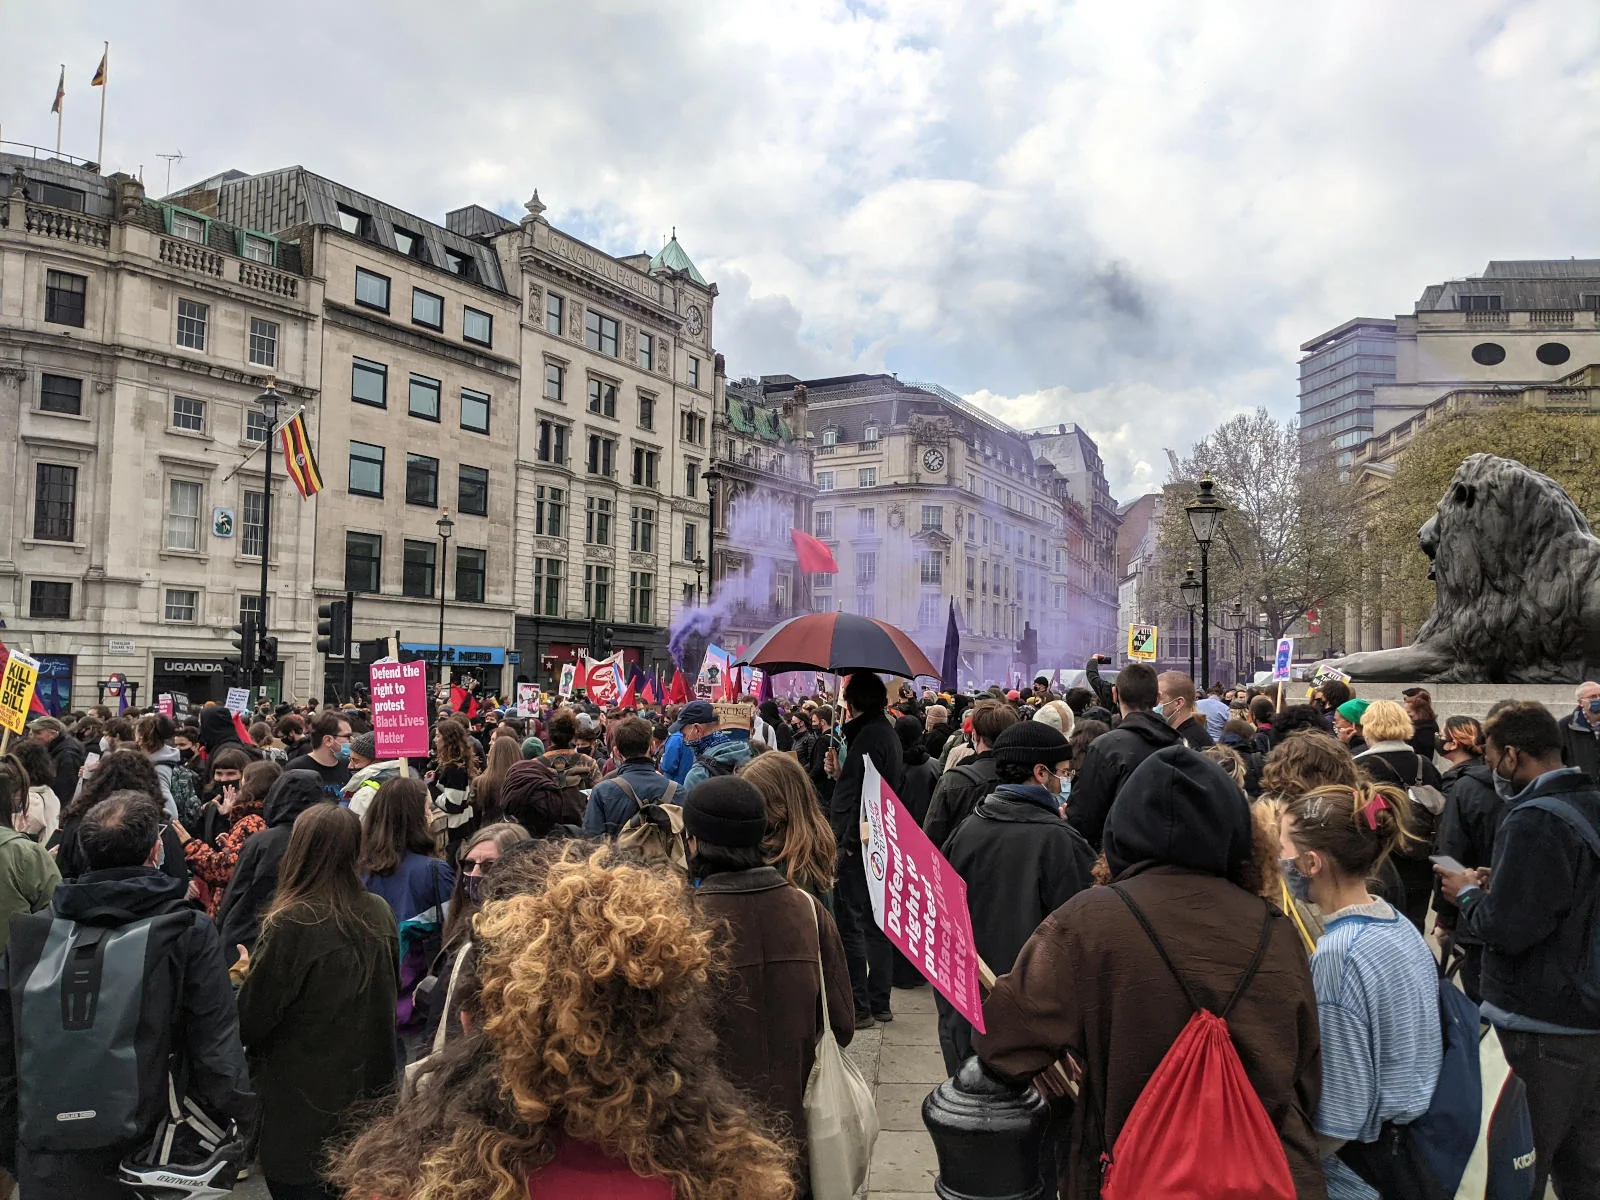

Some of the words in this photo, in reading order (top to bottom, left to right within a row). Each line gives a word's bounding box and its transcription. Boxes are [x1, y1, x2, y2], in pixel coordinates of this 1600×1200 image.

[550, 236, 613, 279] CANADIAN
[616, 266, 658, 298] PACIFIC
[164, 661, 223, 672] UGANDA
[458, 651, 492, 662] NERO
[8, 662, 31, 686] KILL
[372, 665, 401, 680] Defend
[402, 665, 420, 678] the
[5, 676, 27, 698] THE
[374, 683, 393, 698] right
[395, 683, 405, 694] to
[1, 690, 24, 714] BILL
[375, 698, 405, 714] protest
[376, 715, 398, 728] Black
[399, 714, 425, 727] Lives
[377, 731, 404, 744] Matter
[884, 798, 899, 841] the
[906, 853, 919, 882] to
[887, 836, 904, 939] Defend
[931, 851, 949, 915] Lives
[905, 883, 921, 958] right
[920, 873, 938, 980] protest
[937, 914, 952, 994] Black
[953, 916, 968, 1010] Matter
[156, 1175, 206, 1187] SPECIALIZED
